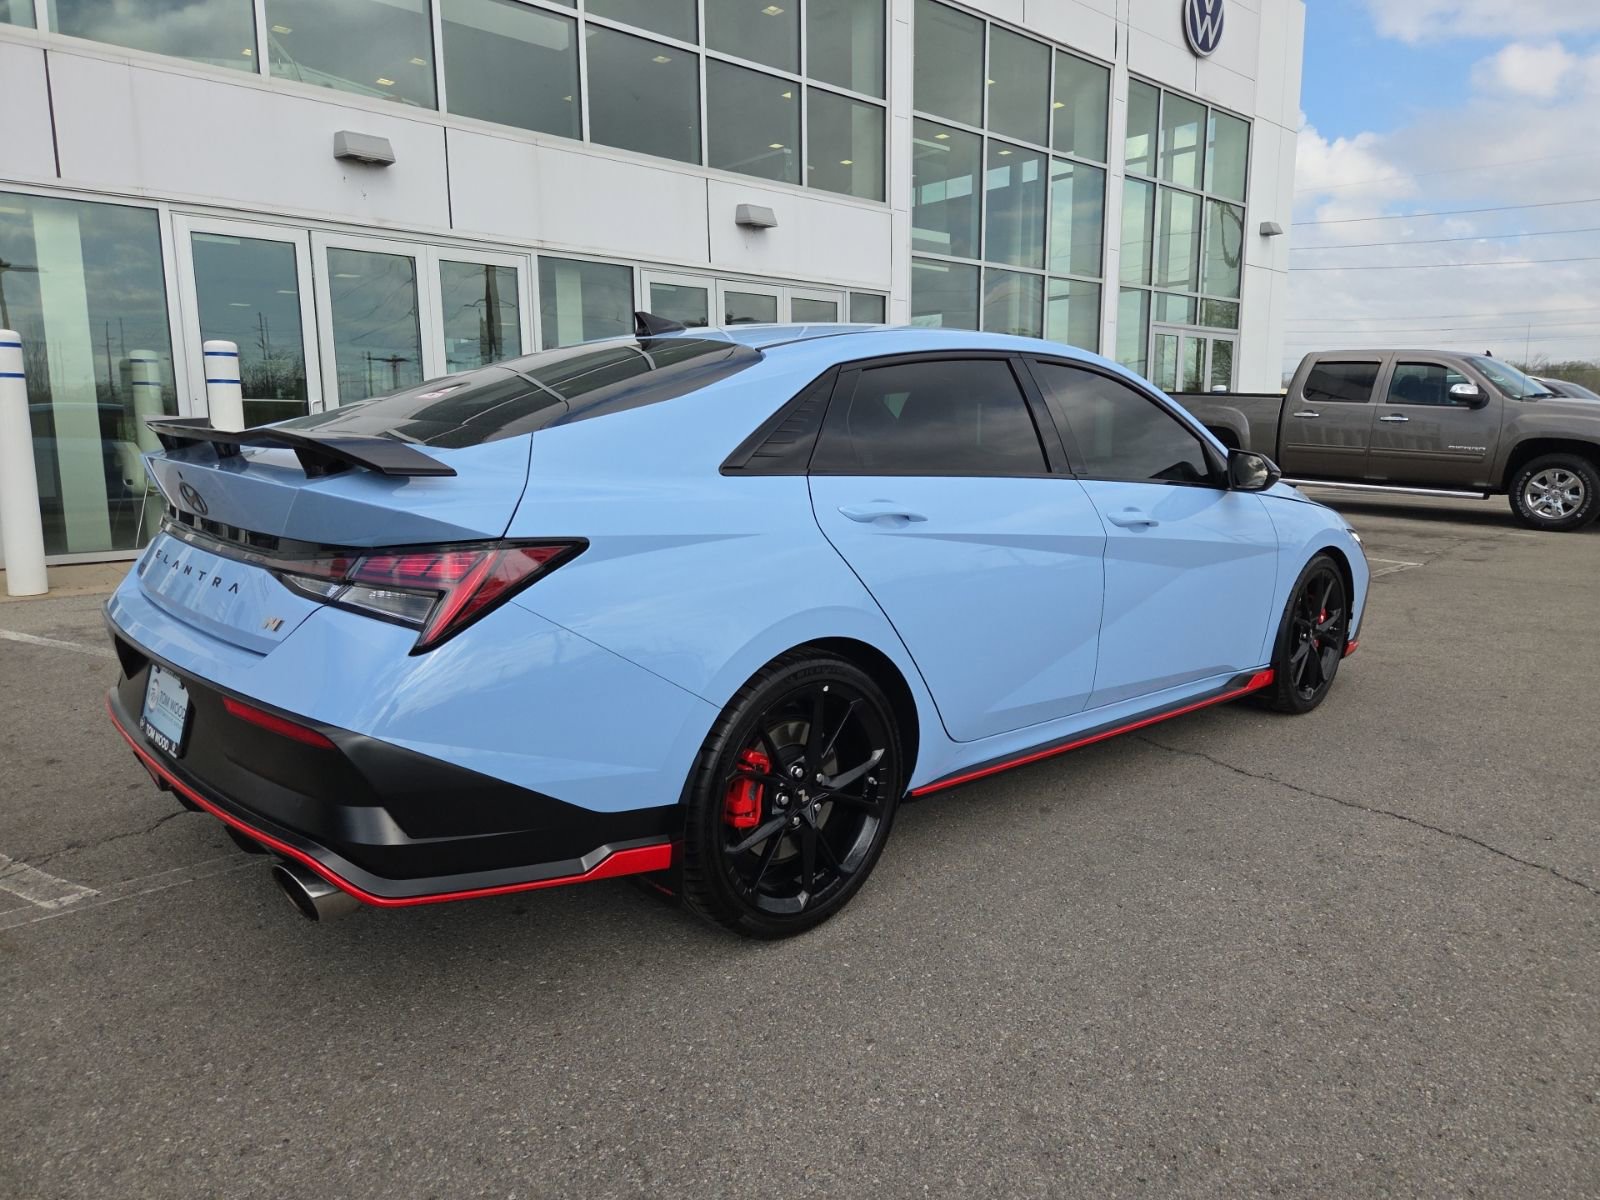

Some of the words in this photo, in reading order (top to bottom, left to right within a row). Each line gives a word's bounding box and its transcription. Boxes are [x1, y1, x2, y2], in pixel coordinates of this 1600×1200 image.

[155, 549, 240, 595] ELANTRA
[146, 723, 155, 740] TOM
[154, 732, 169, 751] WOOD
